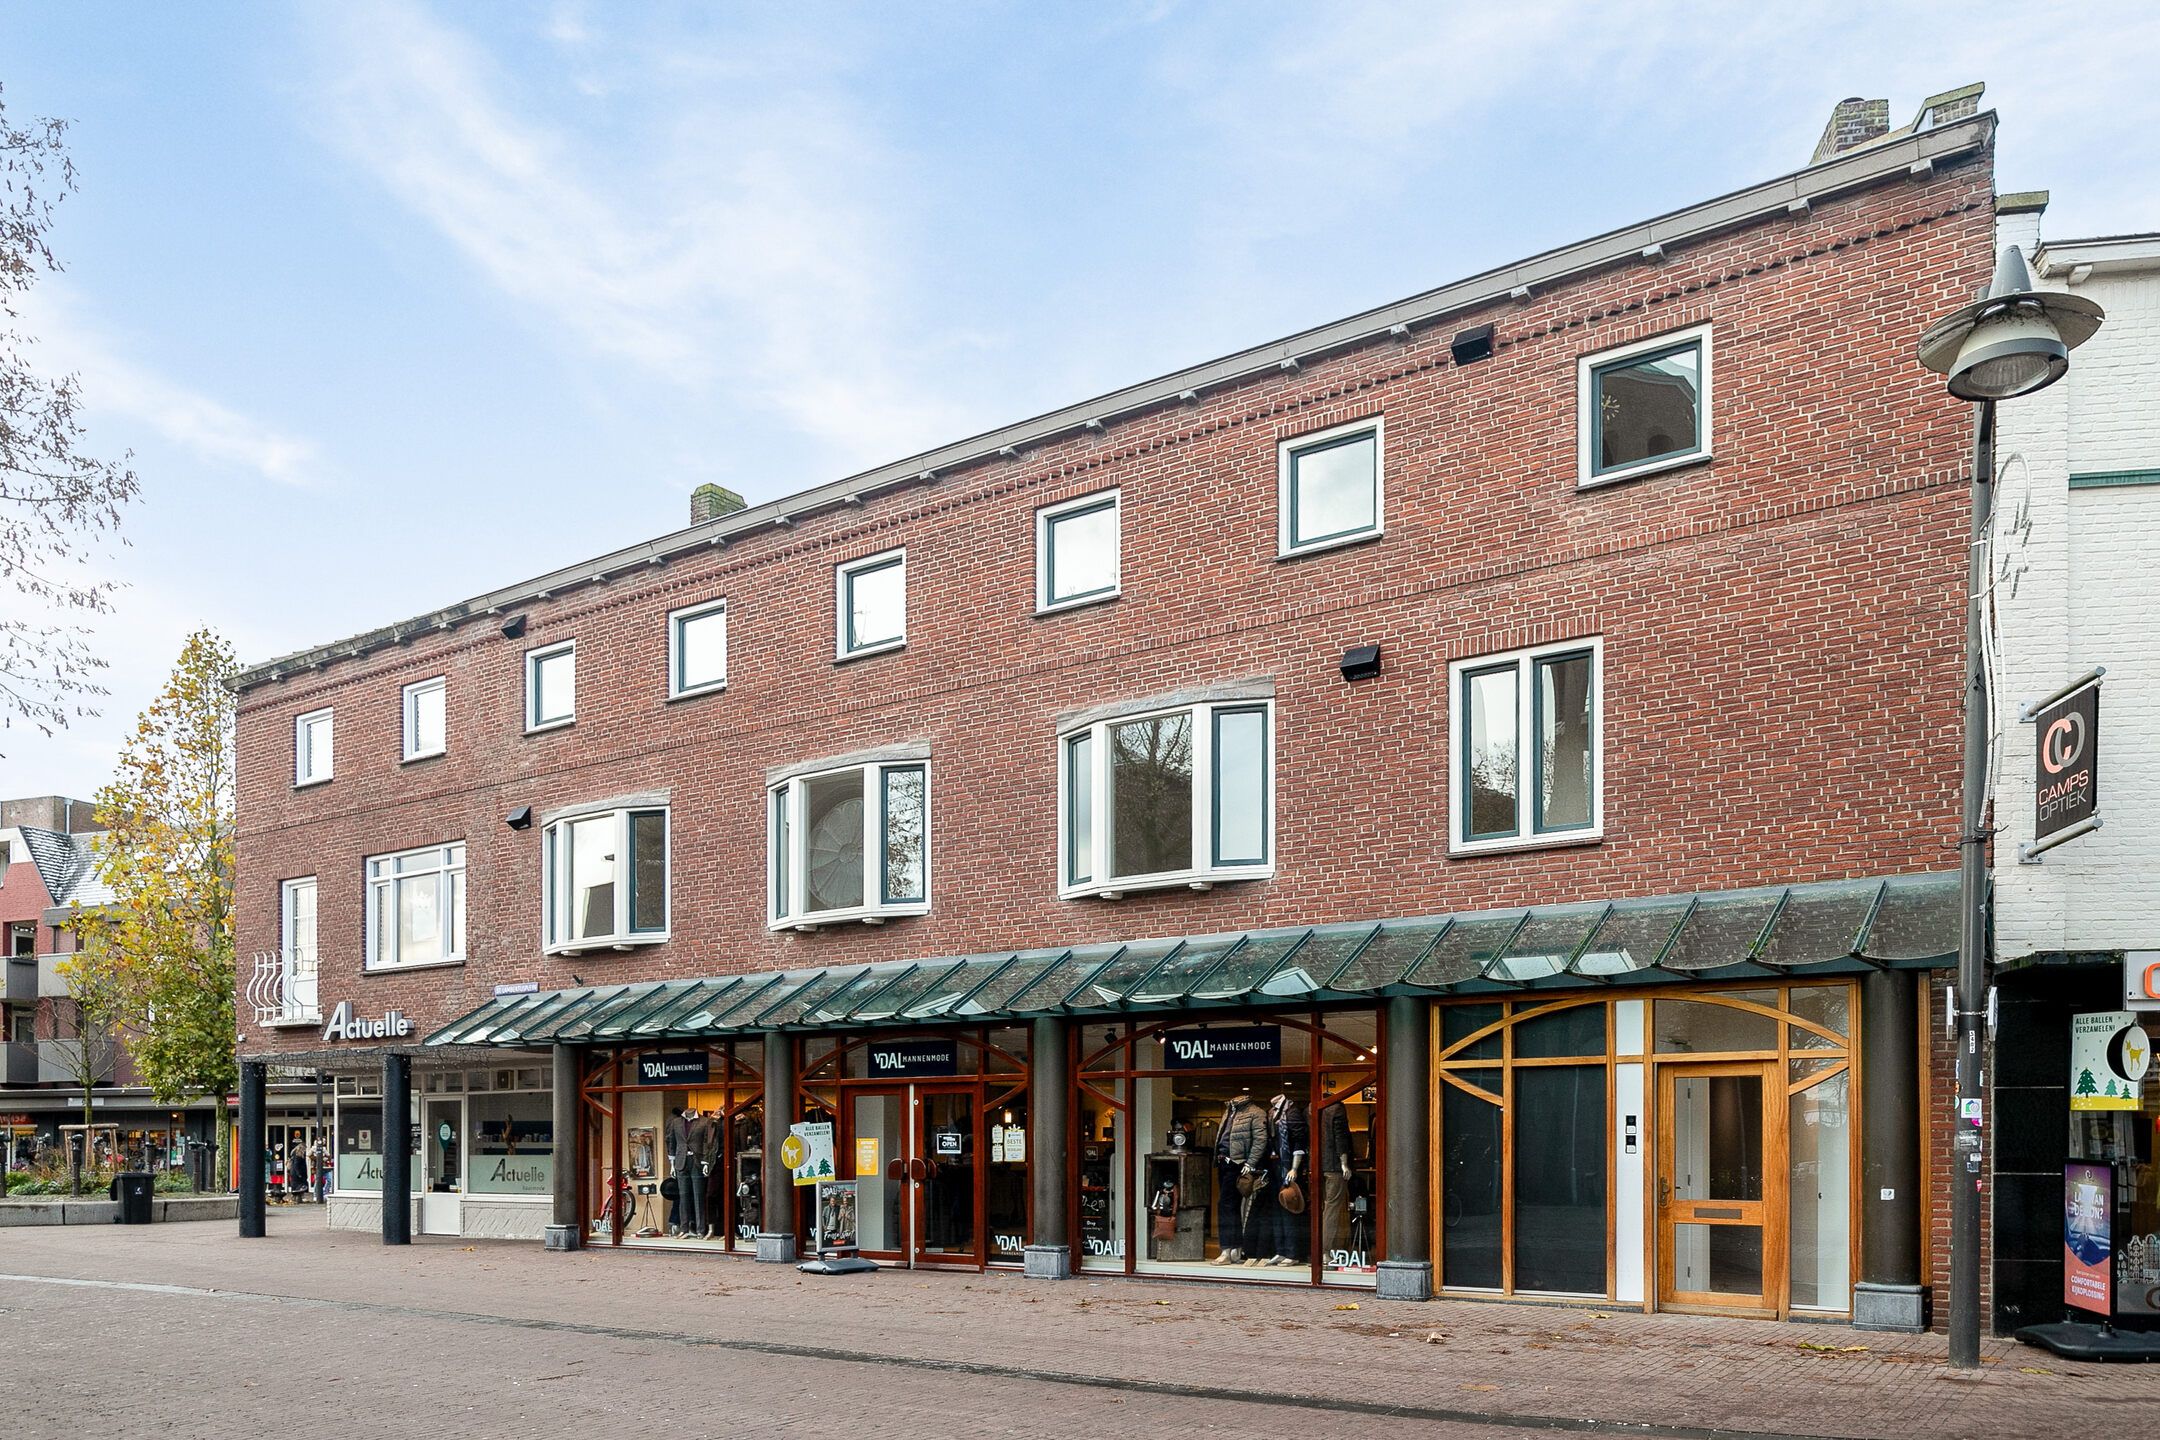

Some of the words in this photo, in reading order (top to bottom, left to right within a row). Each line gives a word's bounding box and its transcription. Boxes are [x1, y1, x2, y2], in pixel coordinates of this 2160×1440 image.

[2038, 769, 2089, 805] CAMPS
[2039, 787, 2087, 822] OPTIEK
[322, 1001, 410, 1041] Actuelle
[2075, 1016, 2089, 1025] ALLE
[2091, 1015, 2113, 1024] BALLEN
[2075, 1024, 2116, 1034] VERZAMELEN!
[1210, 1040, 1272, 1052] MANNENMODE
[902, 1052, 950, 1064] MANNENMODE
[665, 1063, 703, 1072] MANNENMODE
[490, 1158, 545, 1182] Actuelle
[2070, 1275, 2106, 1291] COMFORTABELE
